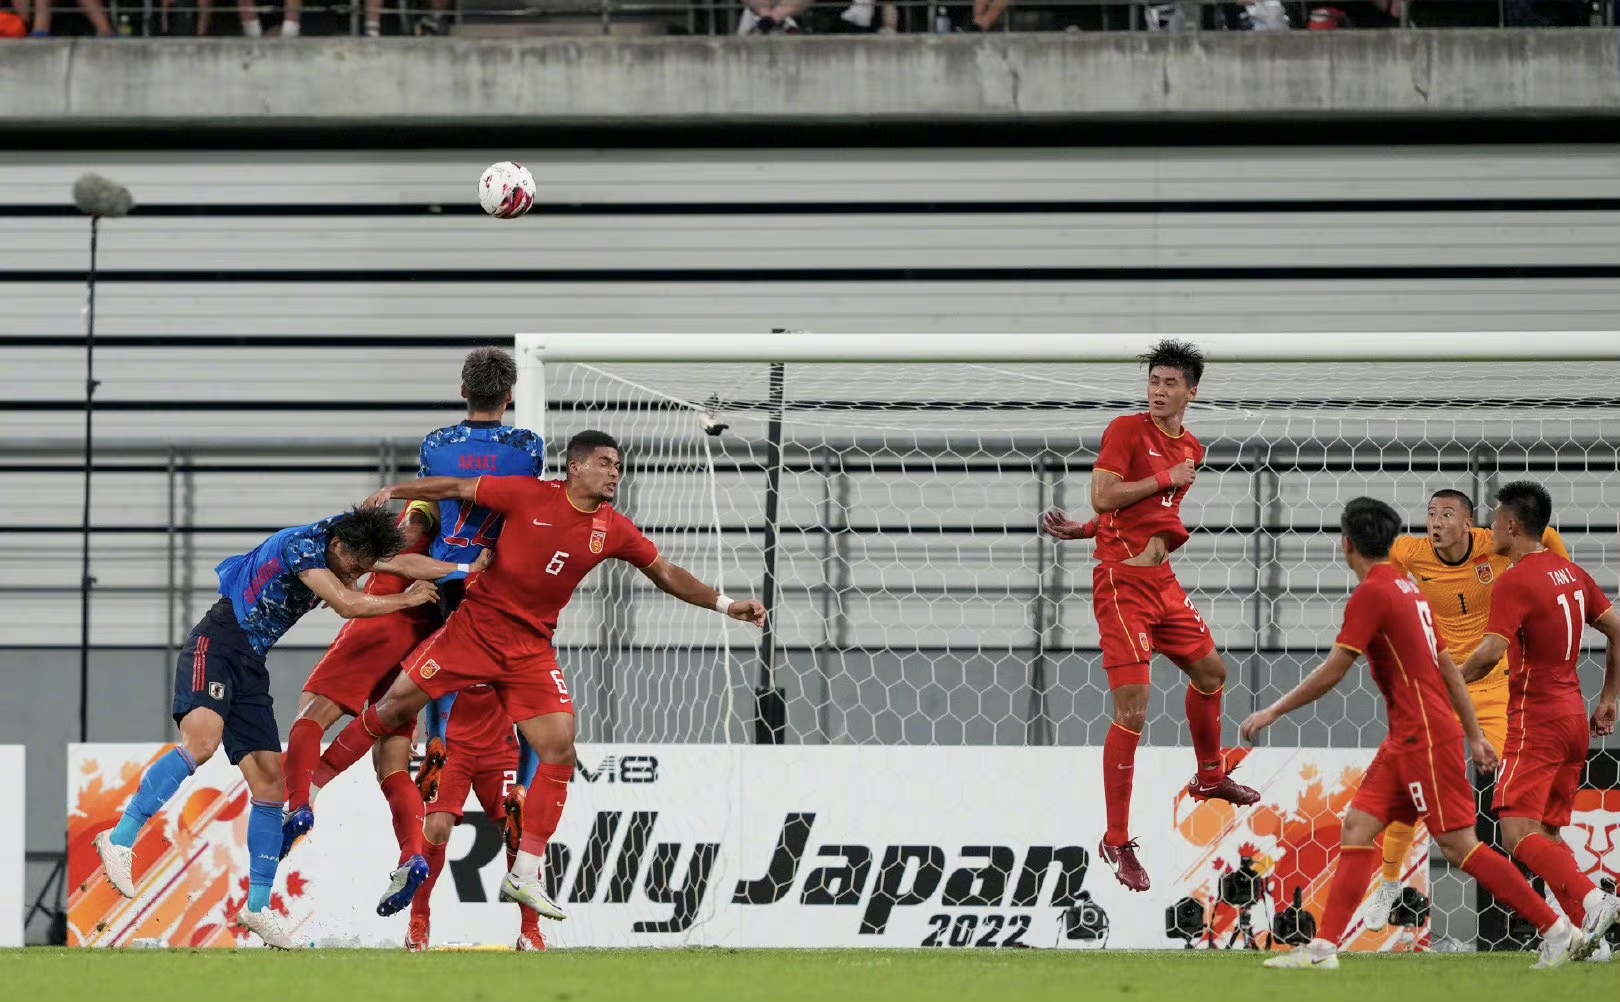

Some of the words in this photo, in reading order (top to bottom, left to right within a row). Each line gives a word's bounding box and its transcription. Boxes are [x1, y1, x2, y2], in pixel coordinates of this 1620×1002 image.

[459, 454, 497, 471] ARAKI
[545, 550, 569, 575] 6
[1457, 593, 1467, 614] 1
[1557, 589, 1586, 661] 11
[550, 670, 568, 694] 6
[503, 770, 517, 797] 2
[1409, 781, 1427, 812] 8
[731, 812, 1090, 935] Japan
[921, 914, 1032, 947] 2022
